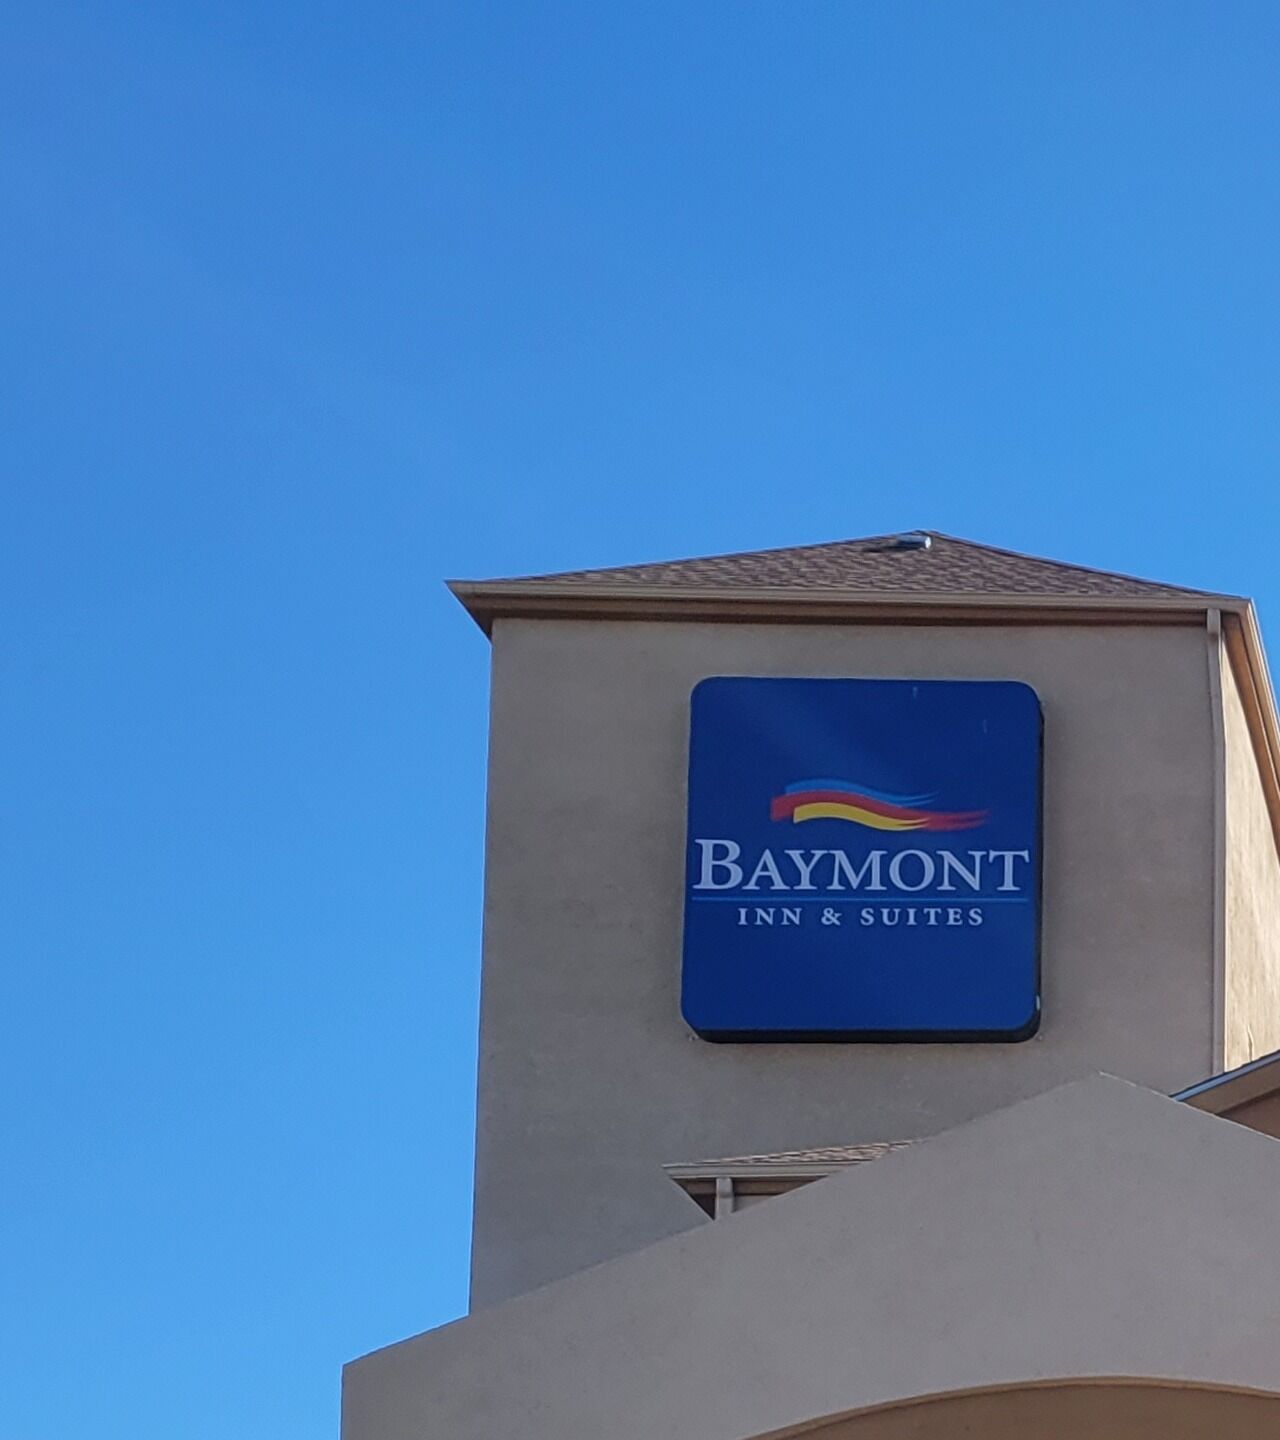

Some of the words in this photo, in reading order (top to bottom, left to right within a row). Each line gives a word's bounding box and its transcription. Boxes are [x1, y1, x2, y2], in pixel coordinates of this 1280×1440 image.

[693, 839, 1030, 891] BAYMONT
[738, 907, 802, 926] INN
[821, 907, 842, 926] &
[860, 907, 984, 926] SUITES
